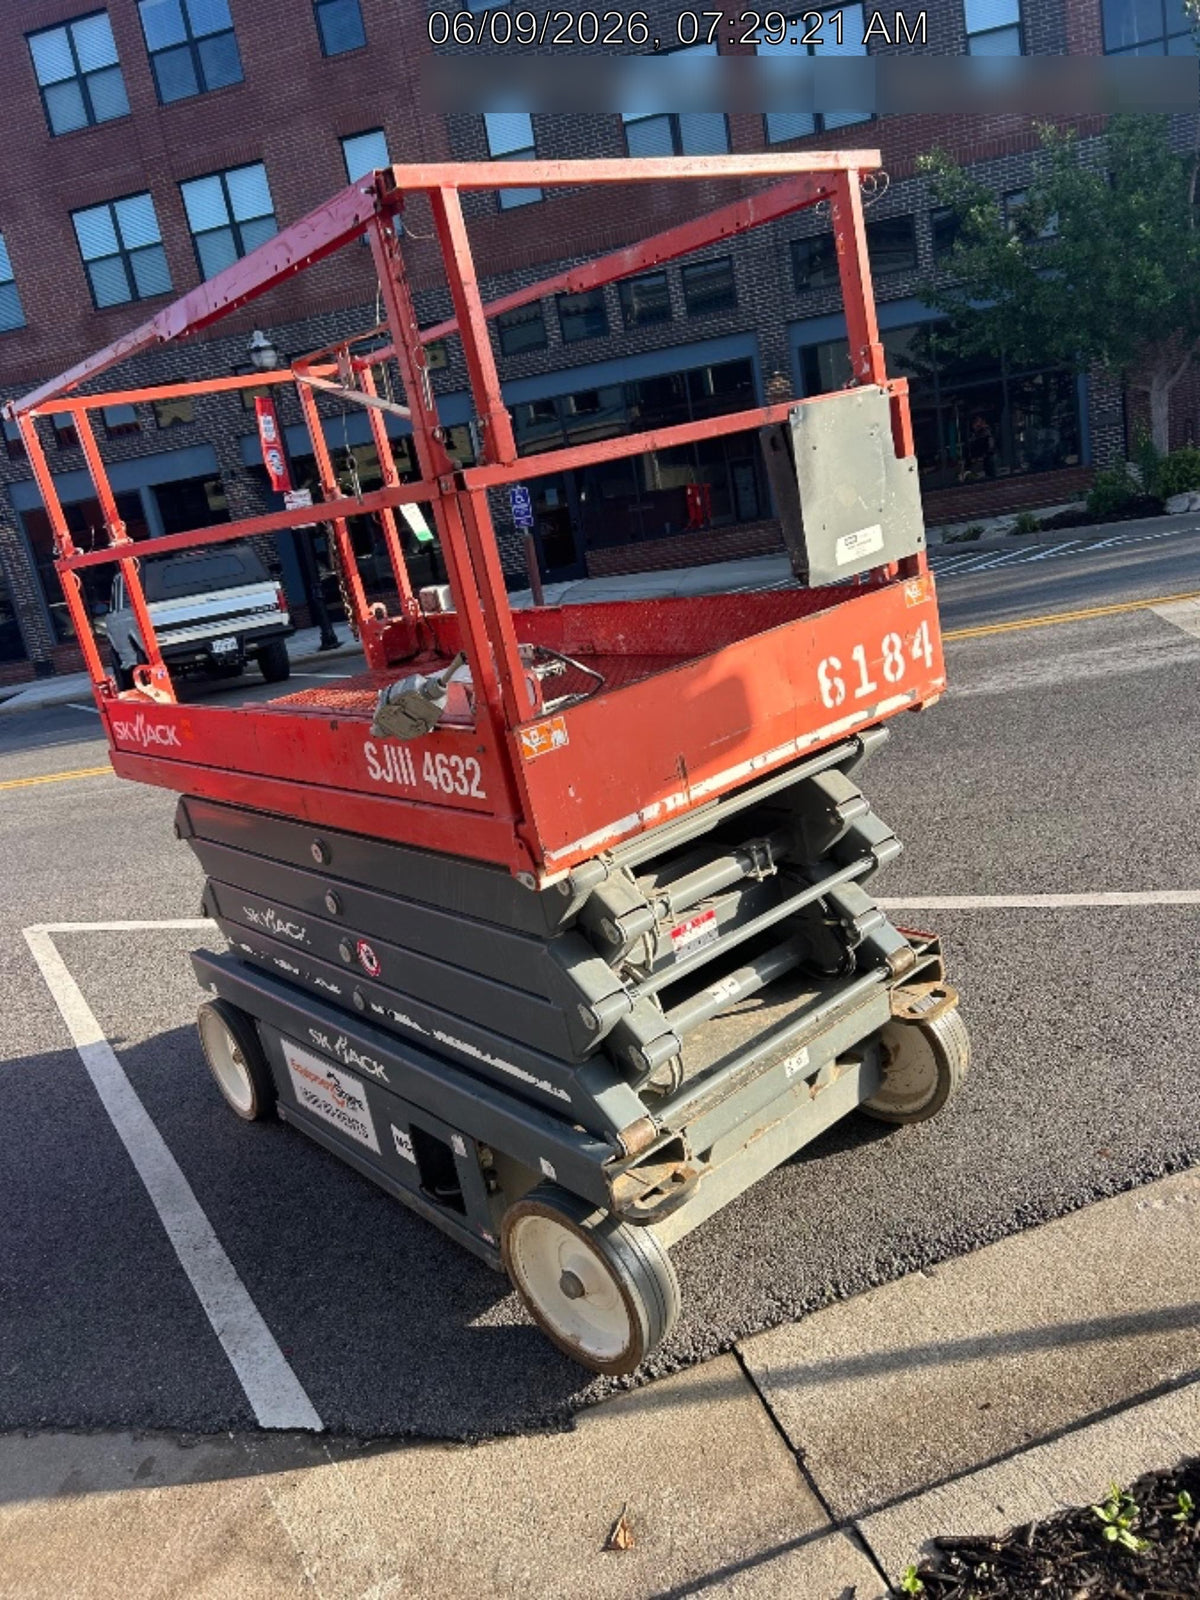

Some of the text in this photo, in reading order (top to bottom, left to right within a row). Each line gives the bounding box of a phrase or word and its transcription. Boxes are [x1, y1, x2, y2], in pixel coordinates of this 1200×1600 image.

[817, 620, 933, 709] 6184
[112, 711, 181, 748] SKYJACK
[364, 741, 487, 799] SJIII 4632
